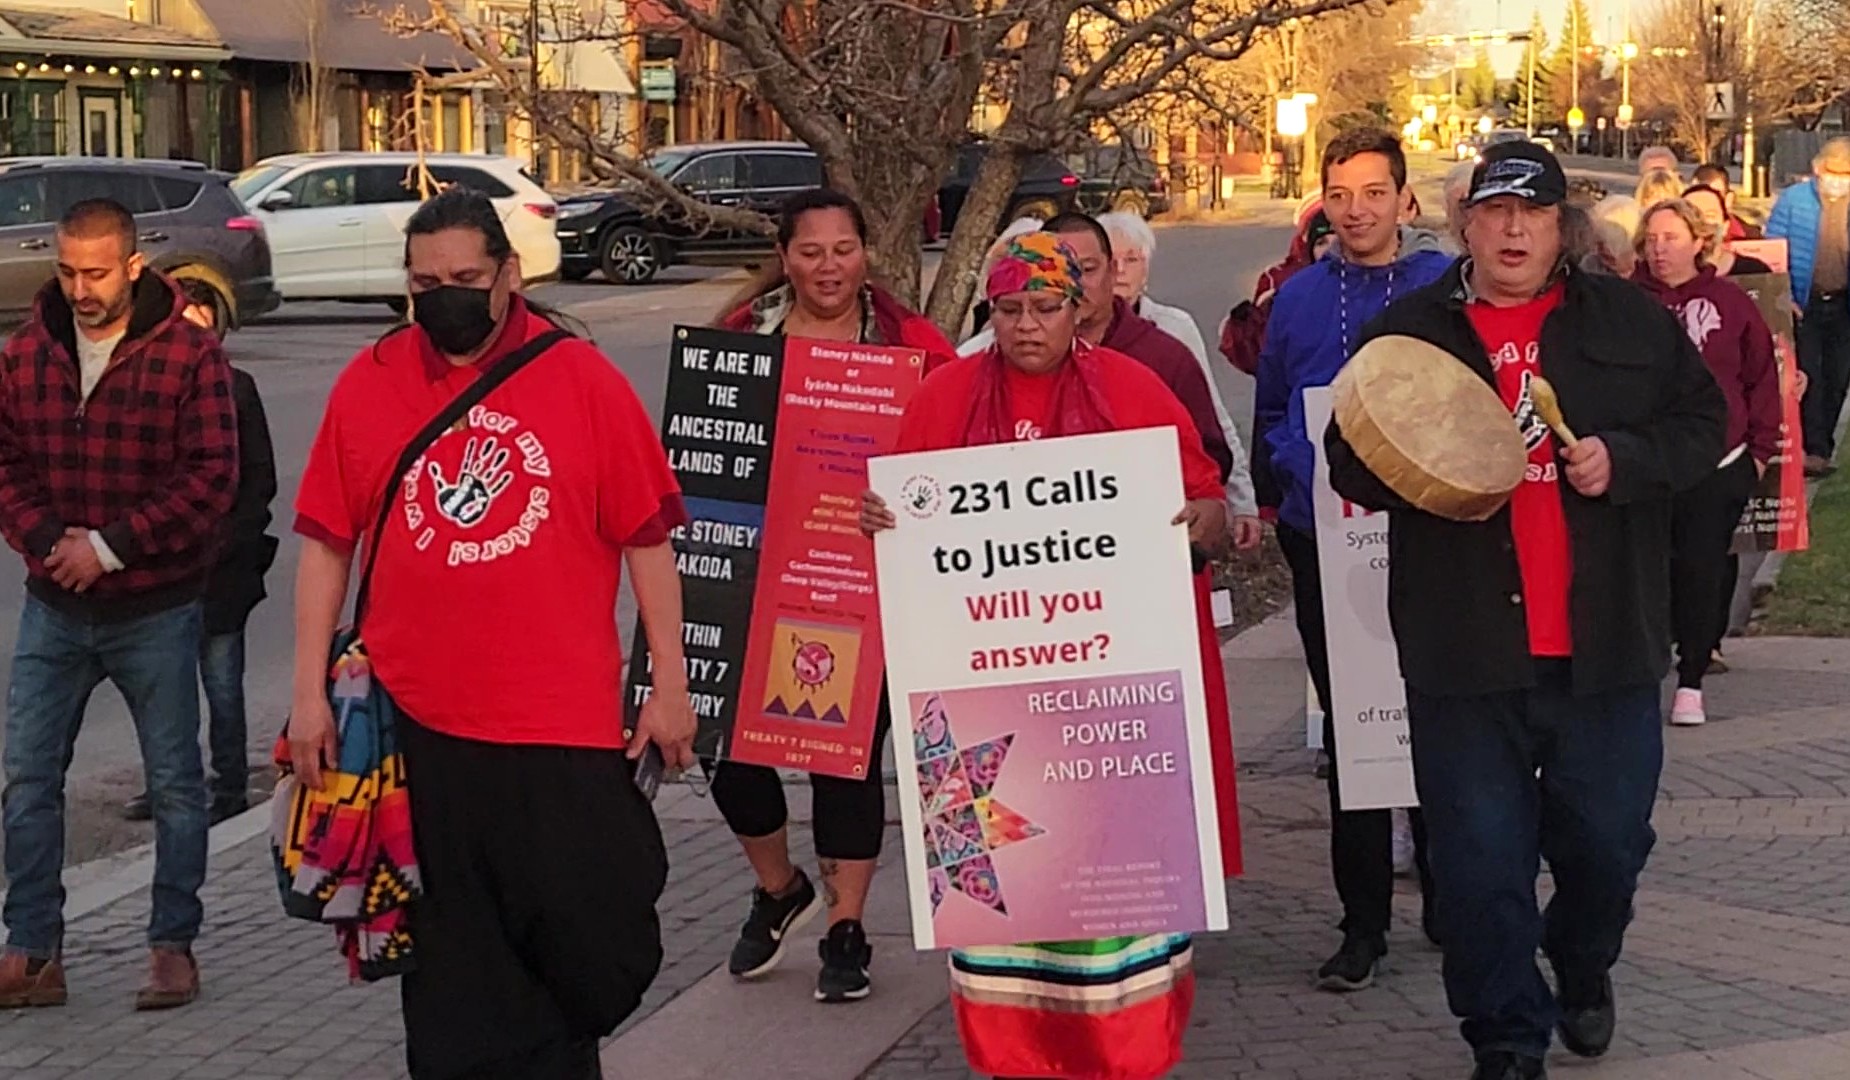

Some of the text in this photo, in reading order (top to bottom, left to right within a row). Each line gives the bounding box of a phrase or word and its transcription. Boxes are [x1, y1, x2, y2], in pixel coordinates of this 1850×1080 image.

[683, 347, 771, 377] WE ARE IN
[811, 346, 850, 362] Stoney
[707, 383, 739, 408] THE
[468, 404, 518, 434] for
[515, 431, 551, 477] my
[668, 414, 767, 446] ANCESTRAL
[668, 448, 757, 478] LANDS OF
[949, 480, 1011, 515] 231
[1025, 469, 1118, 507] Calls
[691, 520, 759, 548] STONEY
[675, 552, 732, 581] AKODA
[933, 530, 1117, 579] to Justice
[966, 589, 1103, 624] Will you
[682, 622, 722, 648] THIN
[970, 633, 1111, 671] answer?
[716, 661, 729, 683] 7
[1028, 681, 1175, 714] RECLAIMING
[1357, 706, 1374, 724] of
[1062, 720, 1147, 748] POWER
[1043, 751, 1176, 784] AND PLACE
